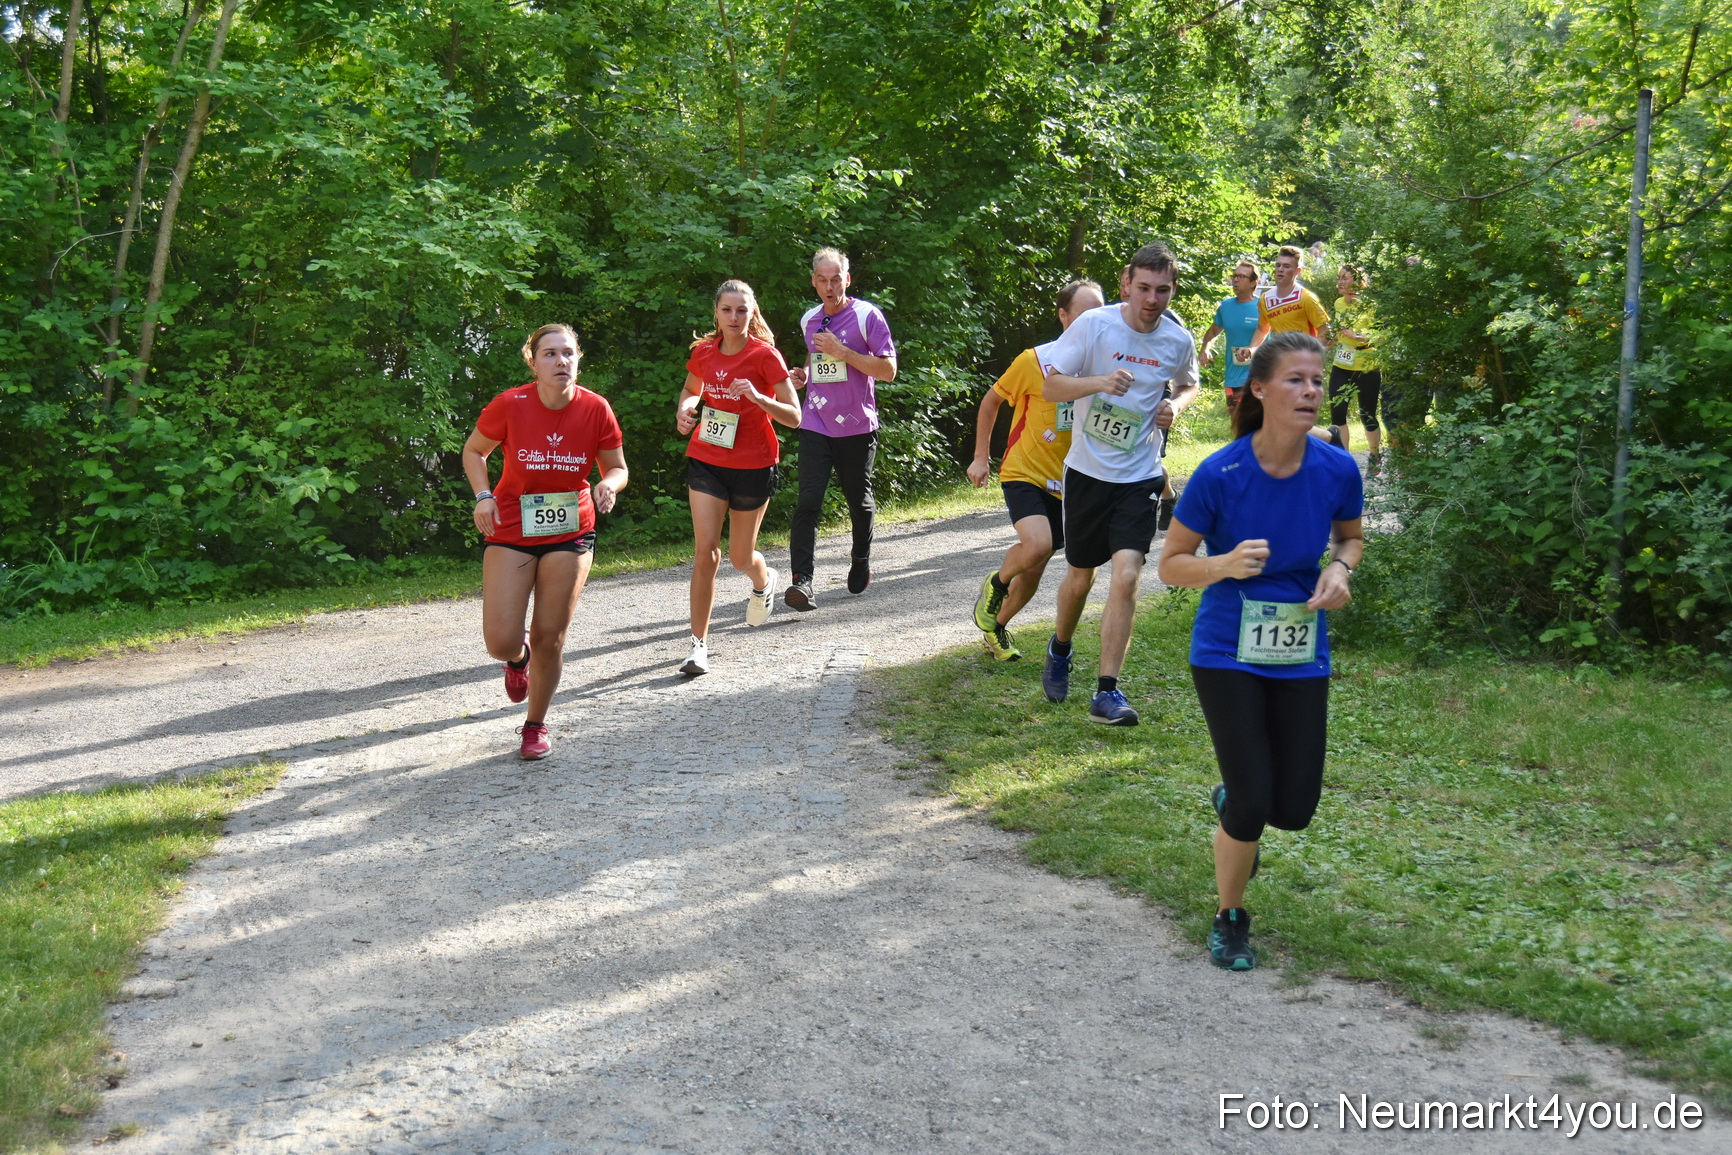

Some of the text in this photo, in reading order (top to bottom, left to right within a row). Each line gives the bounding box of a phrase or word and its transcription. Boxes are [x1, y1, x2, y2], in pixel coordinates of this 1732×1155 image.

[817, 363, 837, 375] 893
[1126, 355, 1160, 367] KLEBL
[706, 420, 727, 436] 597
[1093, 413, 1131, 440] 1151
[518, 448, 587, 465] Echtes Handwerk
[553, 464, 580, 472] FRISCH
[535, 508, 566, 525] 599
[1252, 624, 1308, 647] 1132
